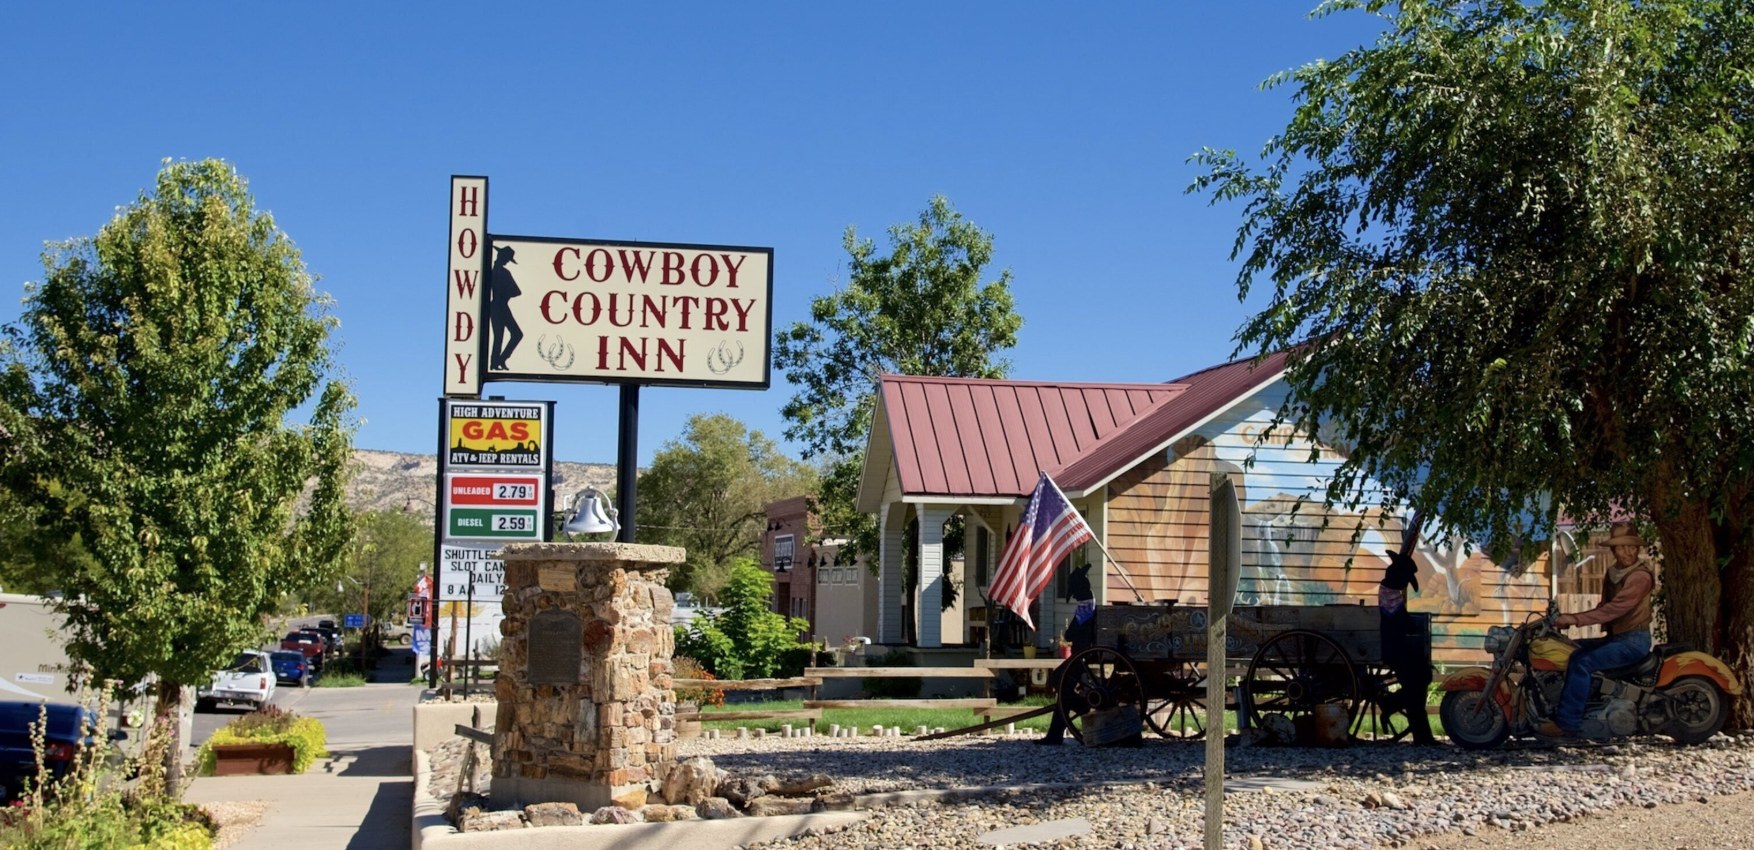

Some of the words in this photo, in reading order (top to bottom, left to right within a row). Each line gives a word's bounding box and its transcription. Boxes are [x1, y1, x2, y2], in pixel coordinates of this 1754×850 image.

[551, 246, 747, 288] COWBOY
[453, 186, 479, 385] HOWDY
[538, 290, 757, 332] COUNTRY
[595, 335, 687, 373] INN
[453, 406, 478, 418] HIGH
[481, 407, 539, 419] ADVENTURE
[462, 421, 529, 440] GAS
[451, 452, 469, 463] ATV
[469, 453, 478, 462] &
[478, 452, 498, 463] JEEP
[500, 453, 539, 464] RENTALS
[452, 486, 491, 495] UNLEADED
[499, 485, 526, 498] 2.79
[457, 518, 484, 527] DIESEL
[498, 517, 526, 530] 2.59
[445, 549, 497, 560] SHUTTLE
[451, 561, 478, 571] SLOT
[470, 573, 503, 584] DAILY
[447, 584, 454, 595] 8
